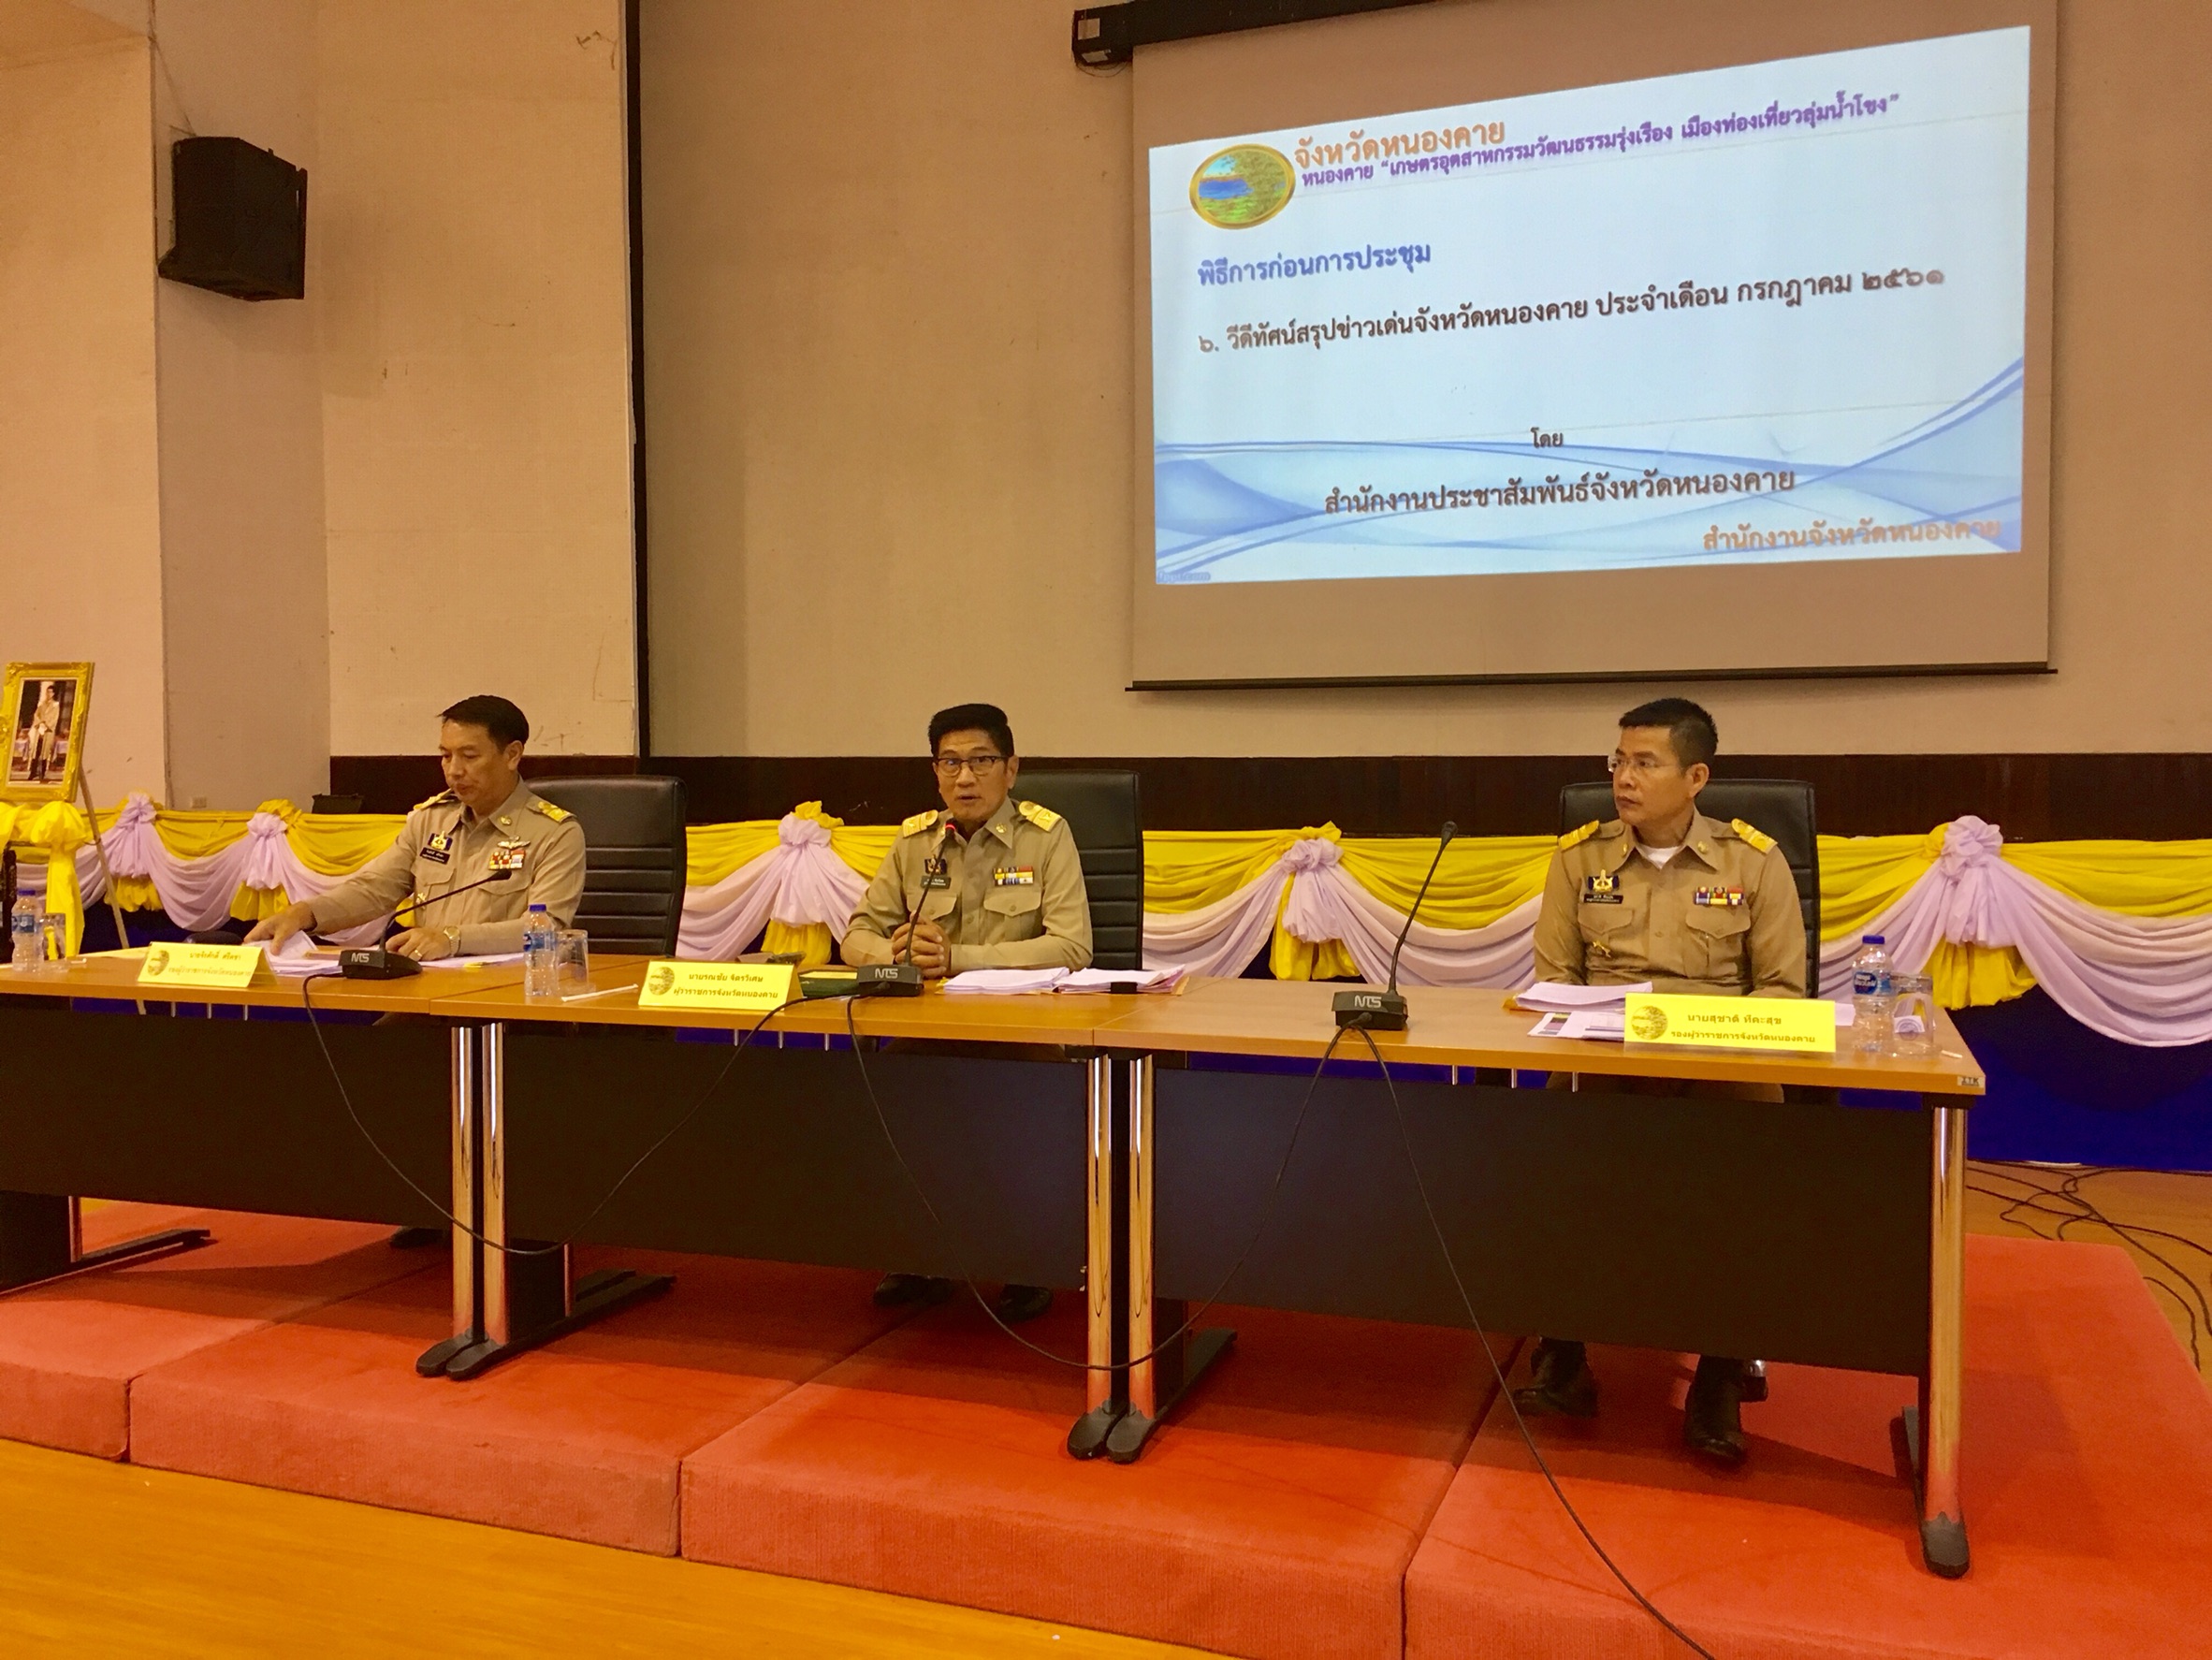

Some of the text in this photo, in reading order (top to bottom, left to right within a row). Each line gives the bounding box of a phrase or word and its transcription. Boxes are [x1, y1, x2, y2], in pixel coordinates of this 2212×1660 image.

[1294, 120, 1505, 170] จังหวัดหนองคาย
[1302, 162, 1375, 188] หนองคาย
[1198, 240, 1432, 286] พิธีการก่อนการประชุม
[1595, 280, 1729, 317] ประจำเดือน
[1738, 271, 1853, 307] กรกฎาคม
[1862, 268, 1946, 292] ๒๕๖๑
[1531, 427, 1564, 449] โดย
[1325, 468, 1796, 515] สำนักงานประชาสัมพันธ์จังหวัดหนองคาย
[1703, 517, 2001, 551] สำนักงานจังหวัดหนองคาย
